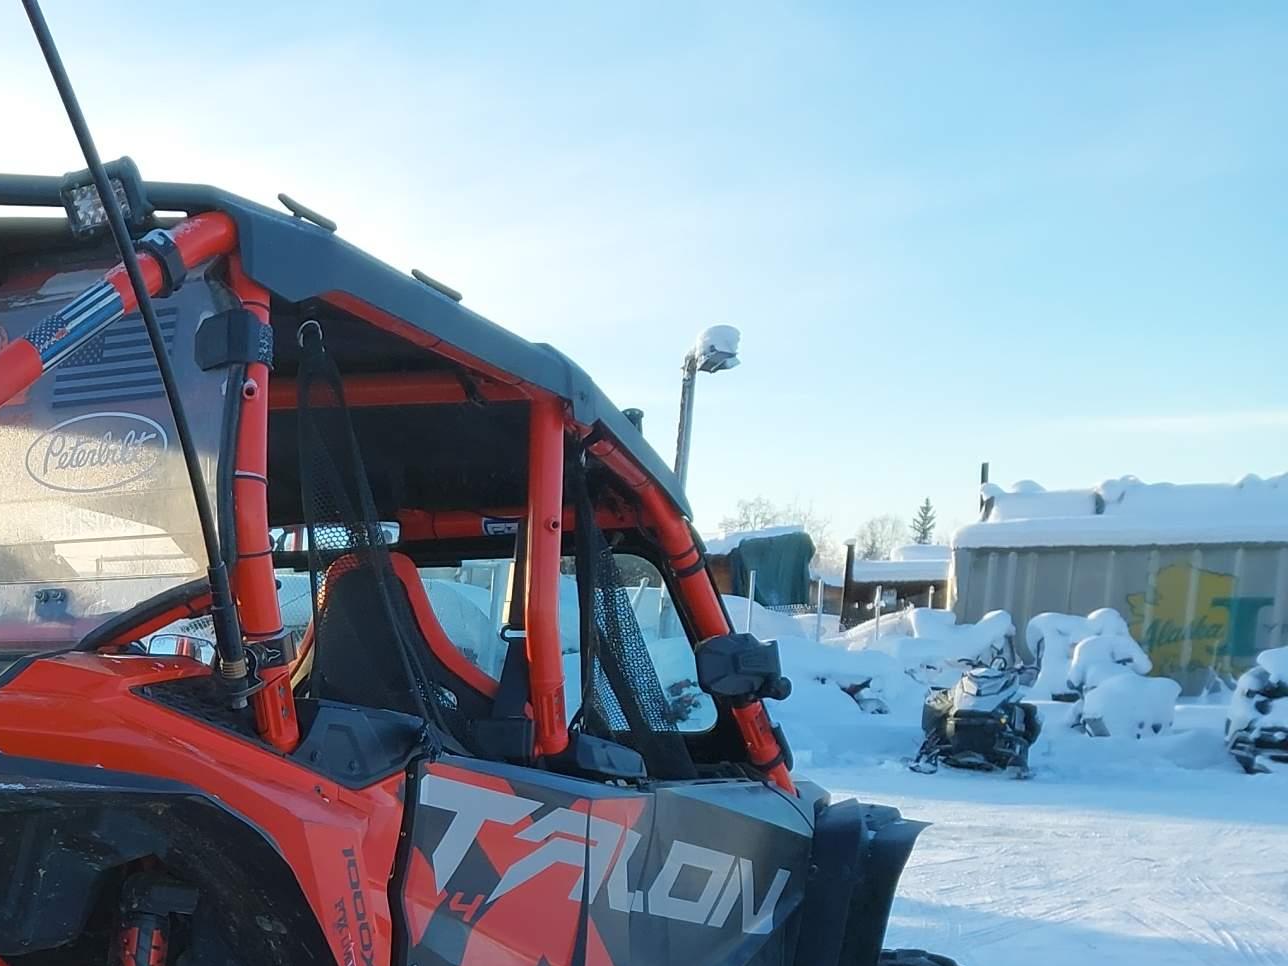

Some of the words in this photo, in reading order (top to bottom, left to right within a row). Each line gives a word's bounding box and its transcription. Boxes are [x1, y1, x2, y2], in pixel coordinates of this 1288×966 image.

[43, 430, 157, 475] Peterbilt
[419, 773, 790, 935] TALON
[449, 890, 486, 923] 4
